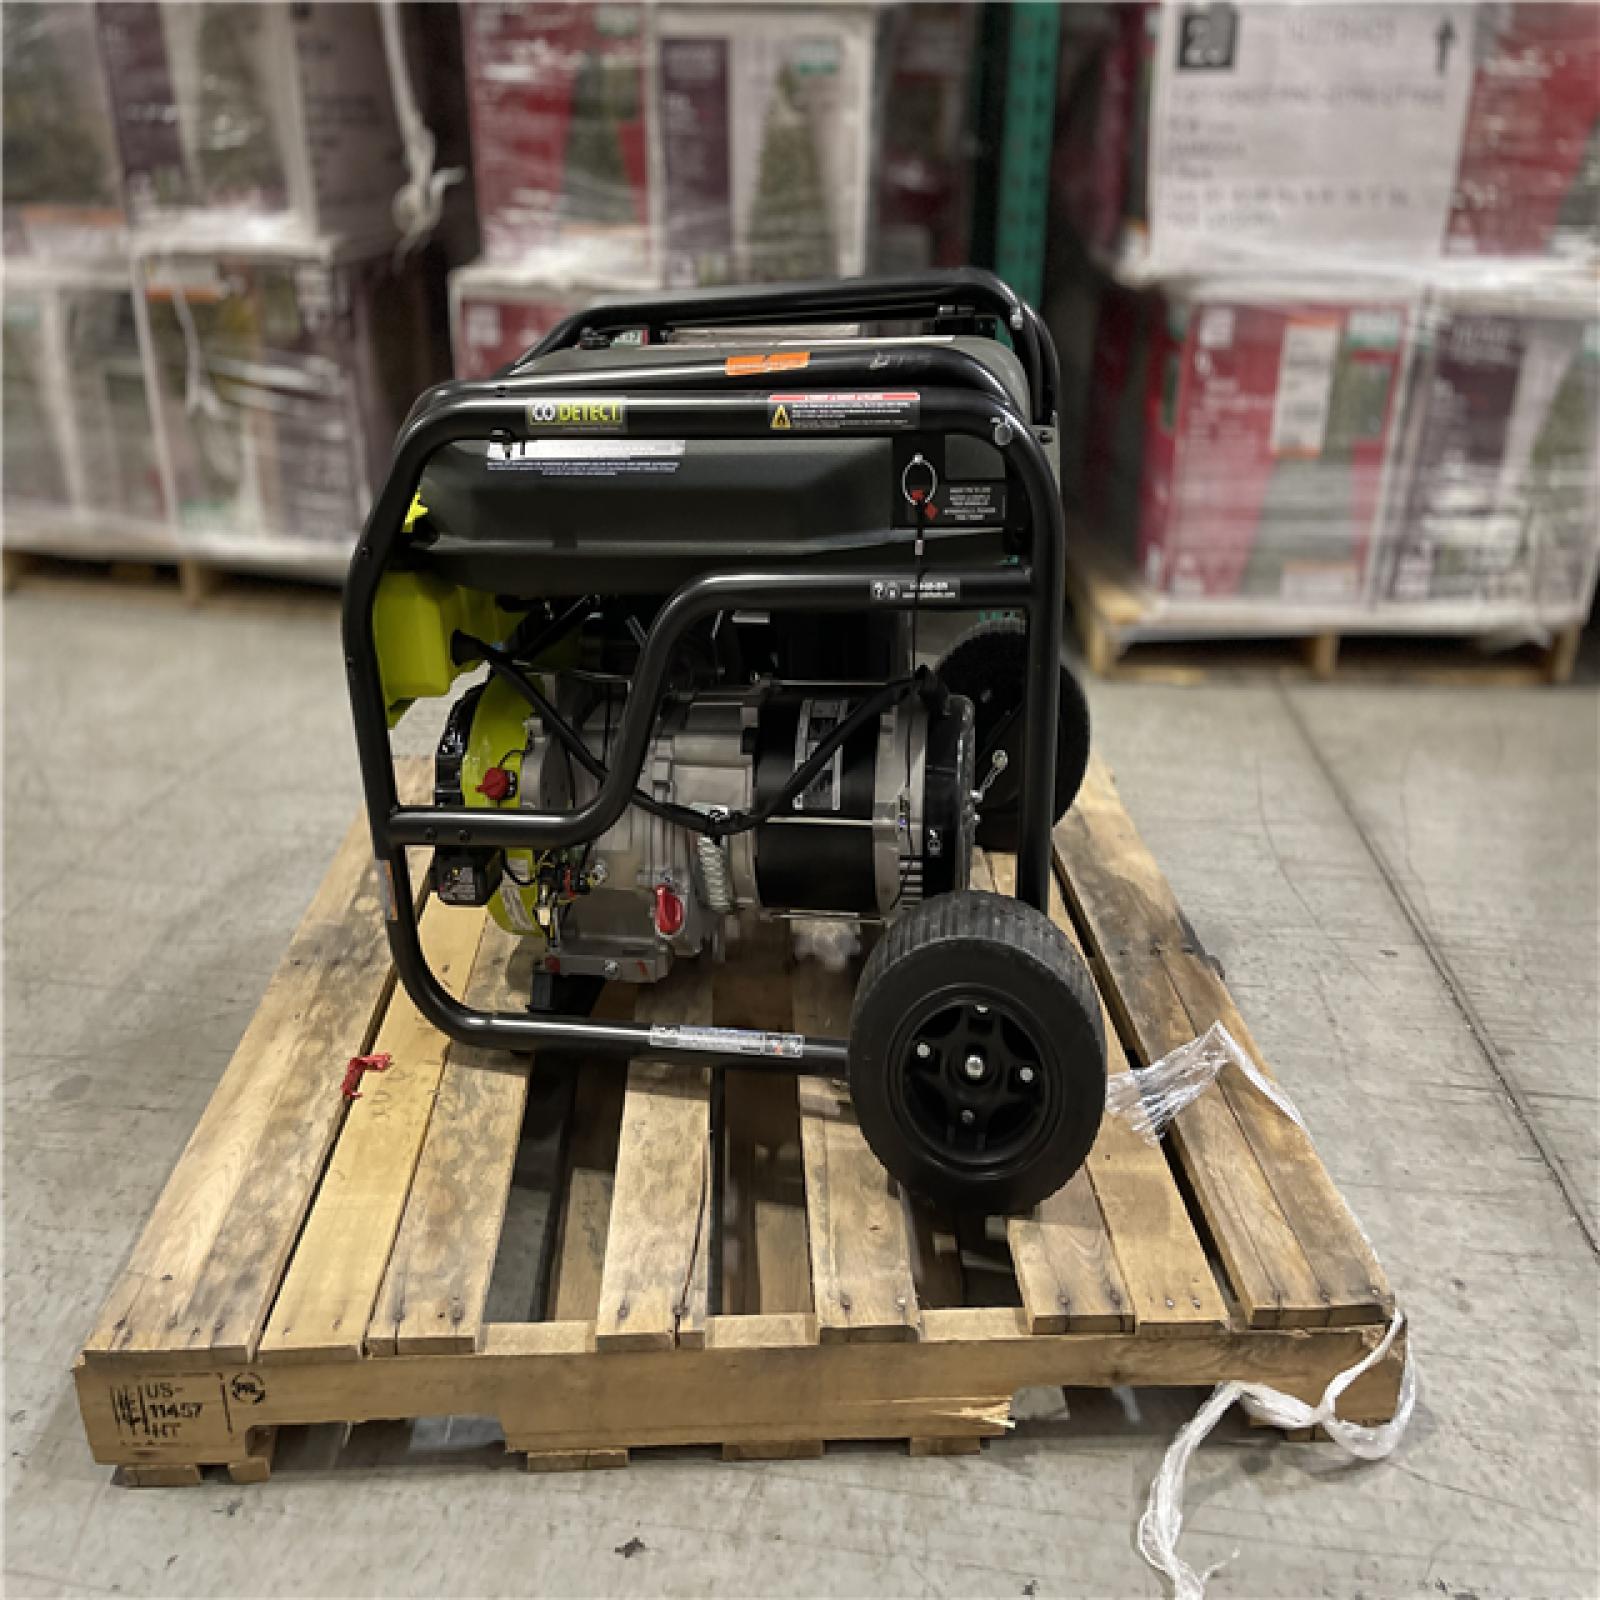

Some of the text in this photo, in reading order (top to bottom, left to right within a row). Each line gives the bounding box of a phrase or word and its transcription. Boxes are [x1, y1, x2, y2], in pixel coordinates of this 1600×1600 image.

[532, 402, 618, 421] CO DETECT
[149, 1401, 203, 1418] 11457
